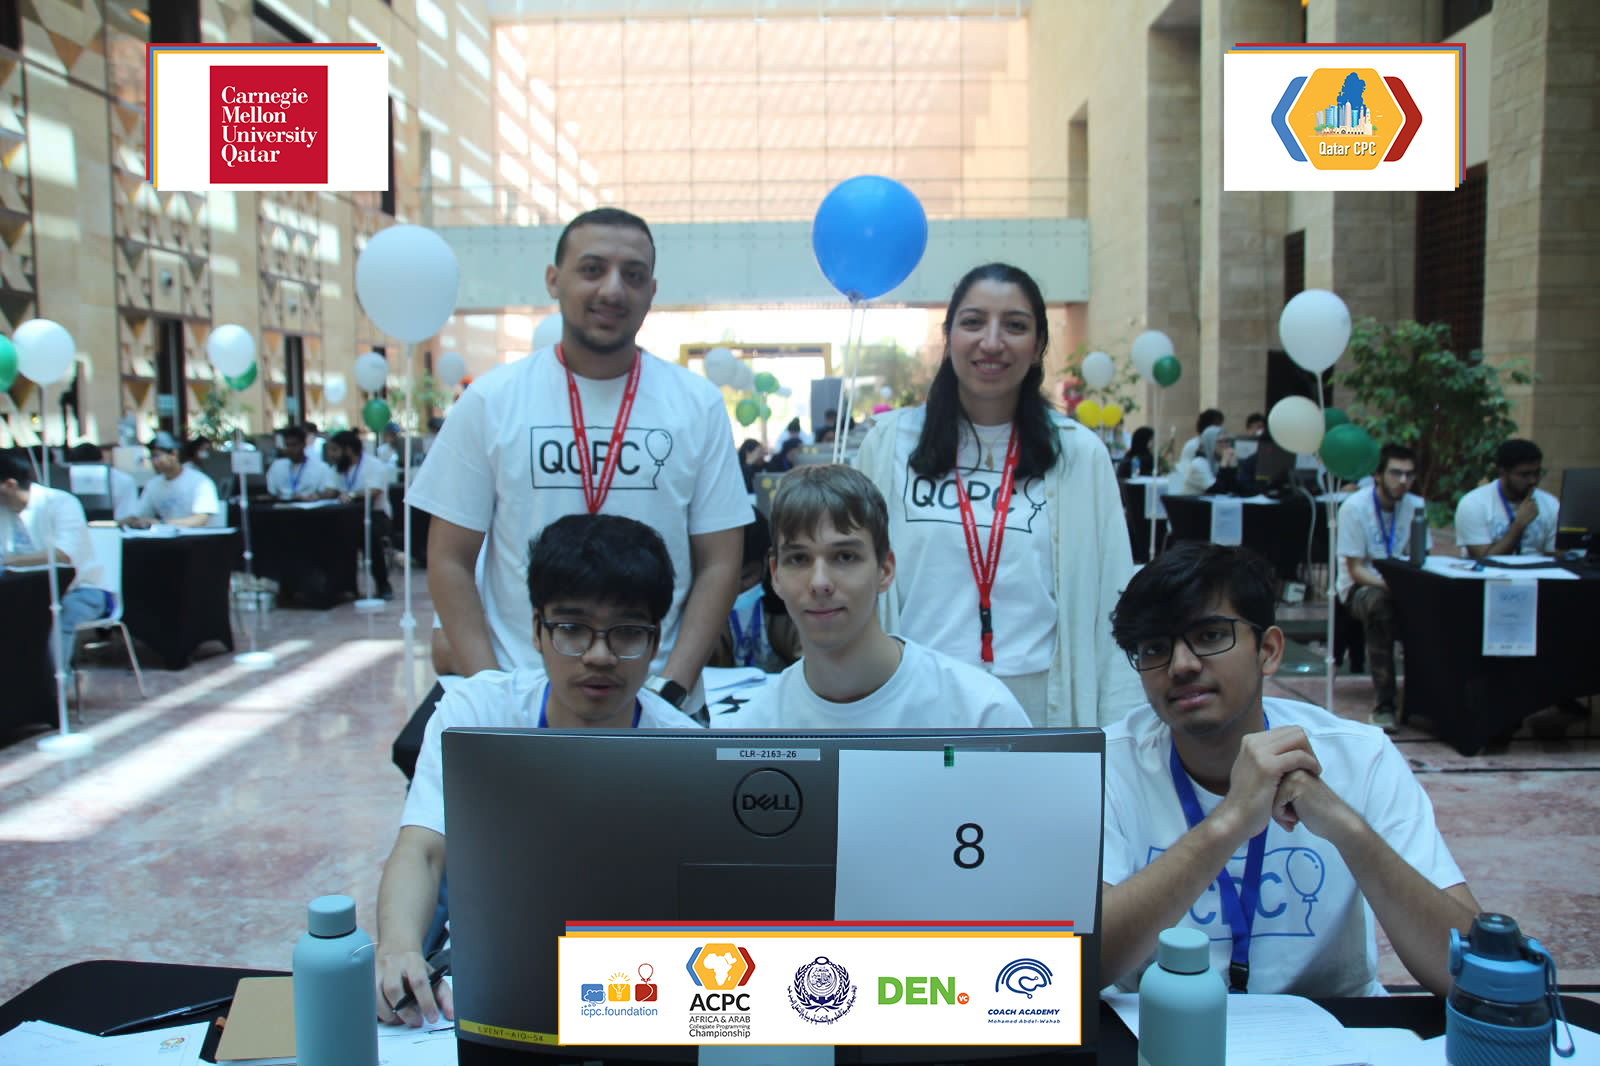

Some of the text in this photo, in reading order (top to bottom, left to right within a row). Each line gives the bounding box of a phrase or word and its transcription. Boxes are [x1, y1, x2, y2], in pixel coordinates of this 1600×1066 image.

[540, 439, 640, 476] QCPC
[912, 475, 1018, 514] QCPC
[739, 749, 797, 759] CLR-2163-26
[742, 794, 796, 811] DELL
[953, 822, 985, 869] 8
